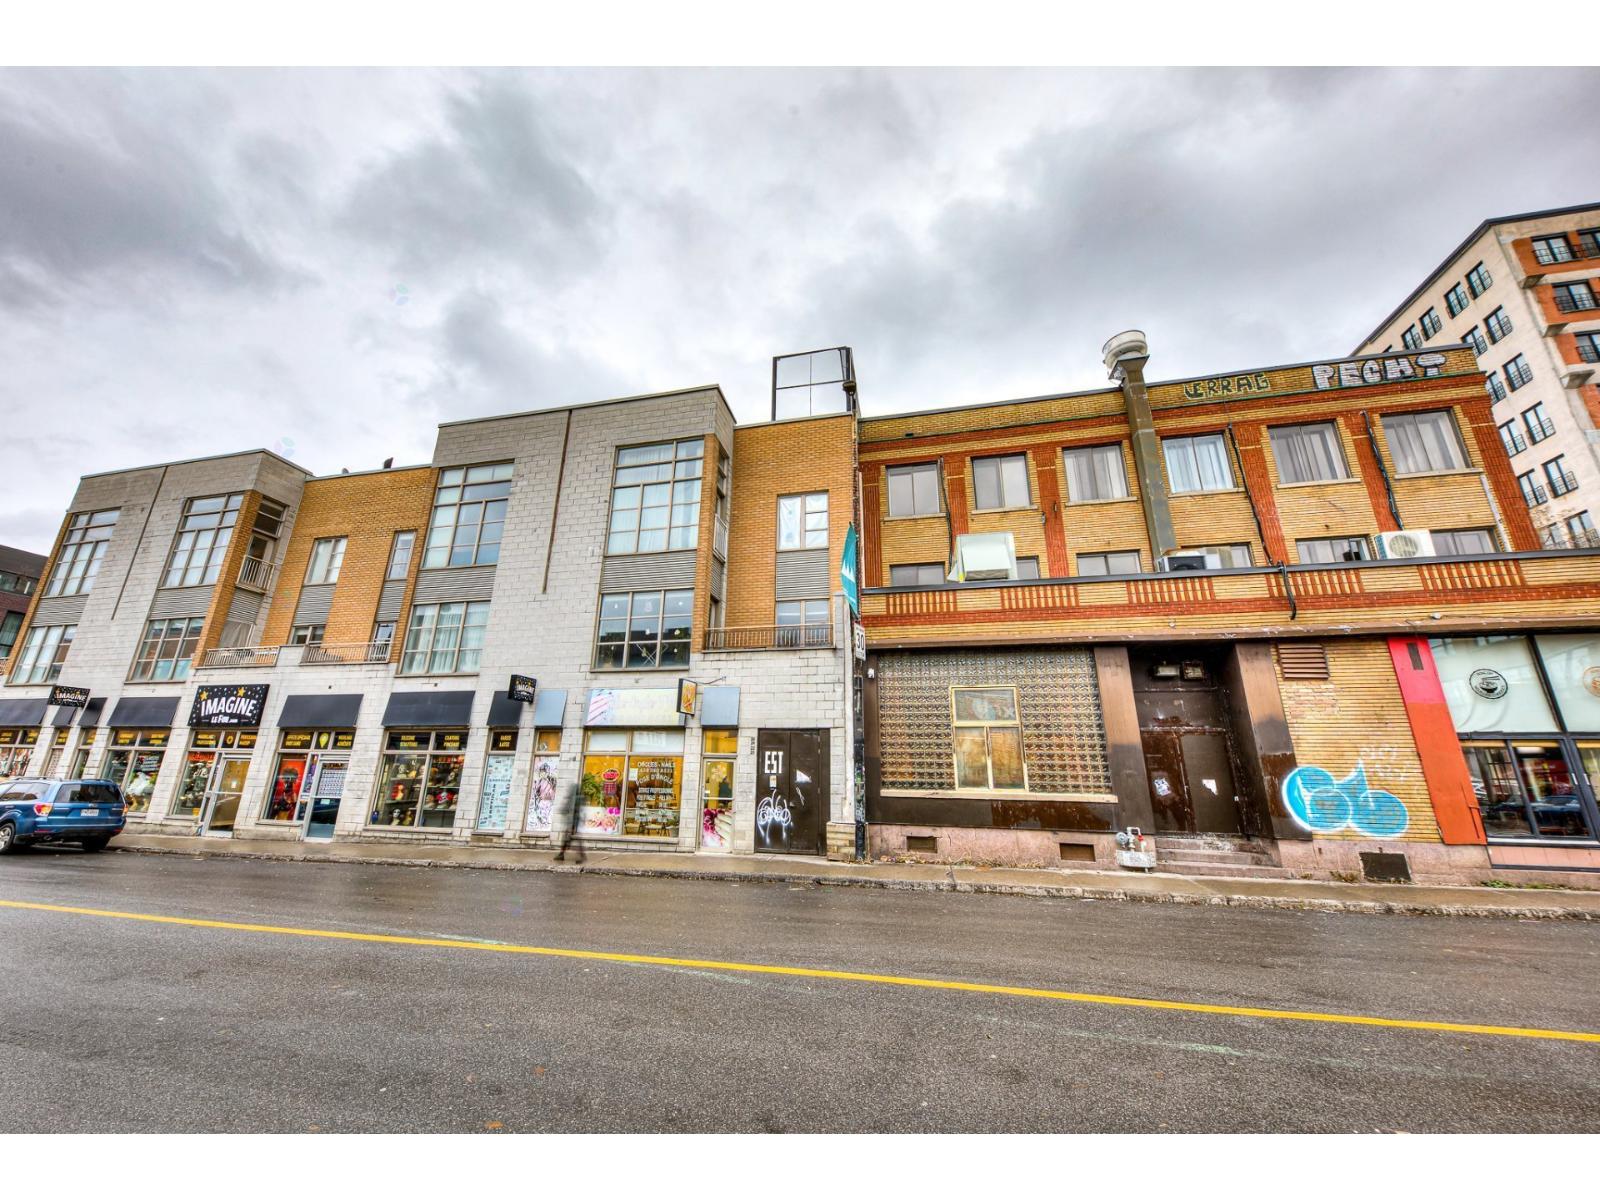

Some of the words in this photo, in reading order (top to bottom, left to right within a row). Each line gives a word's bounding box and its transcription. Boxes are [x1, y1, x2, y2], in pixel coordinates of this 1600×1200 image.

[856, 632, 865, 651] 30
[54, 692, 87, 700] IMAGINE
[200, 696, 257, 717] IMAGINE
[764, 751, 784, 774] EST
